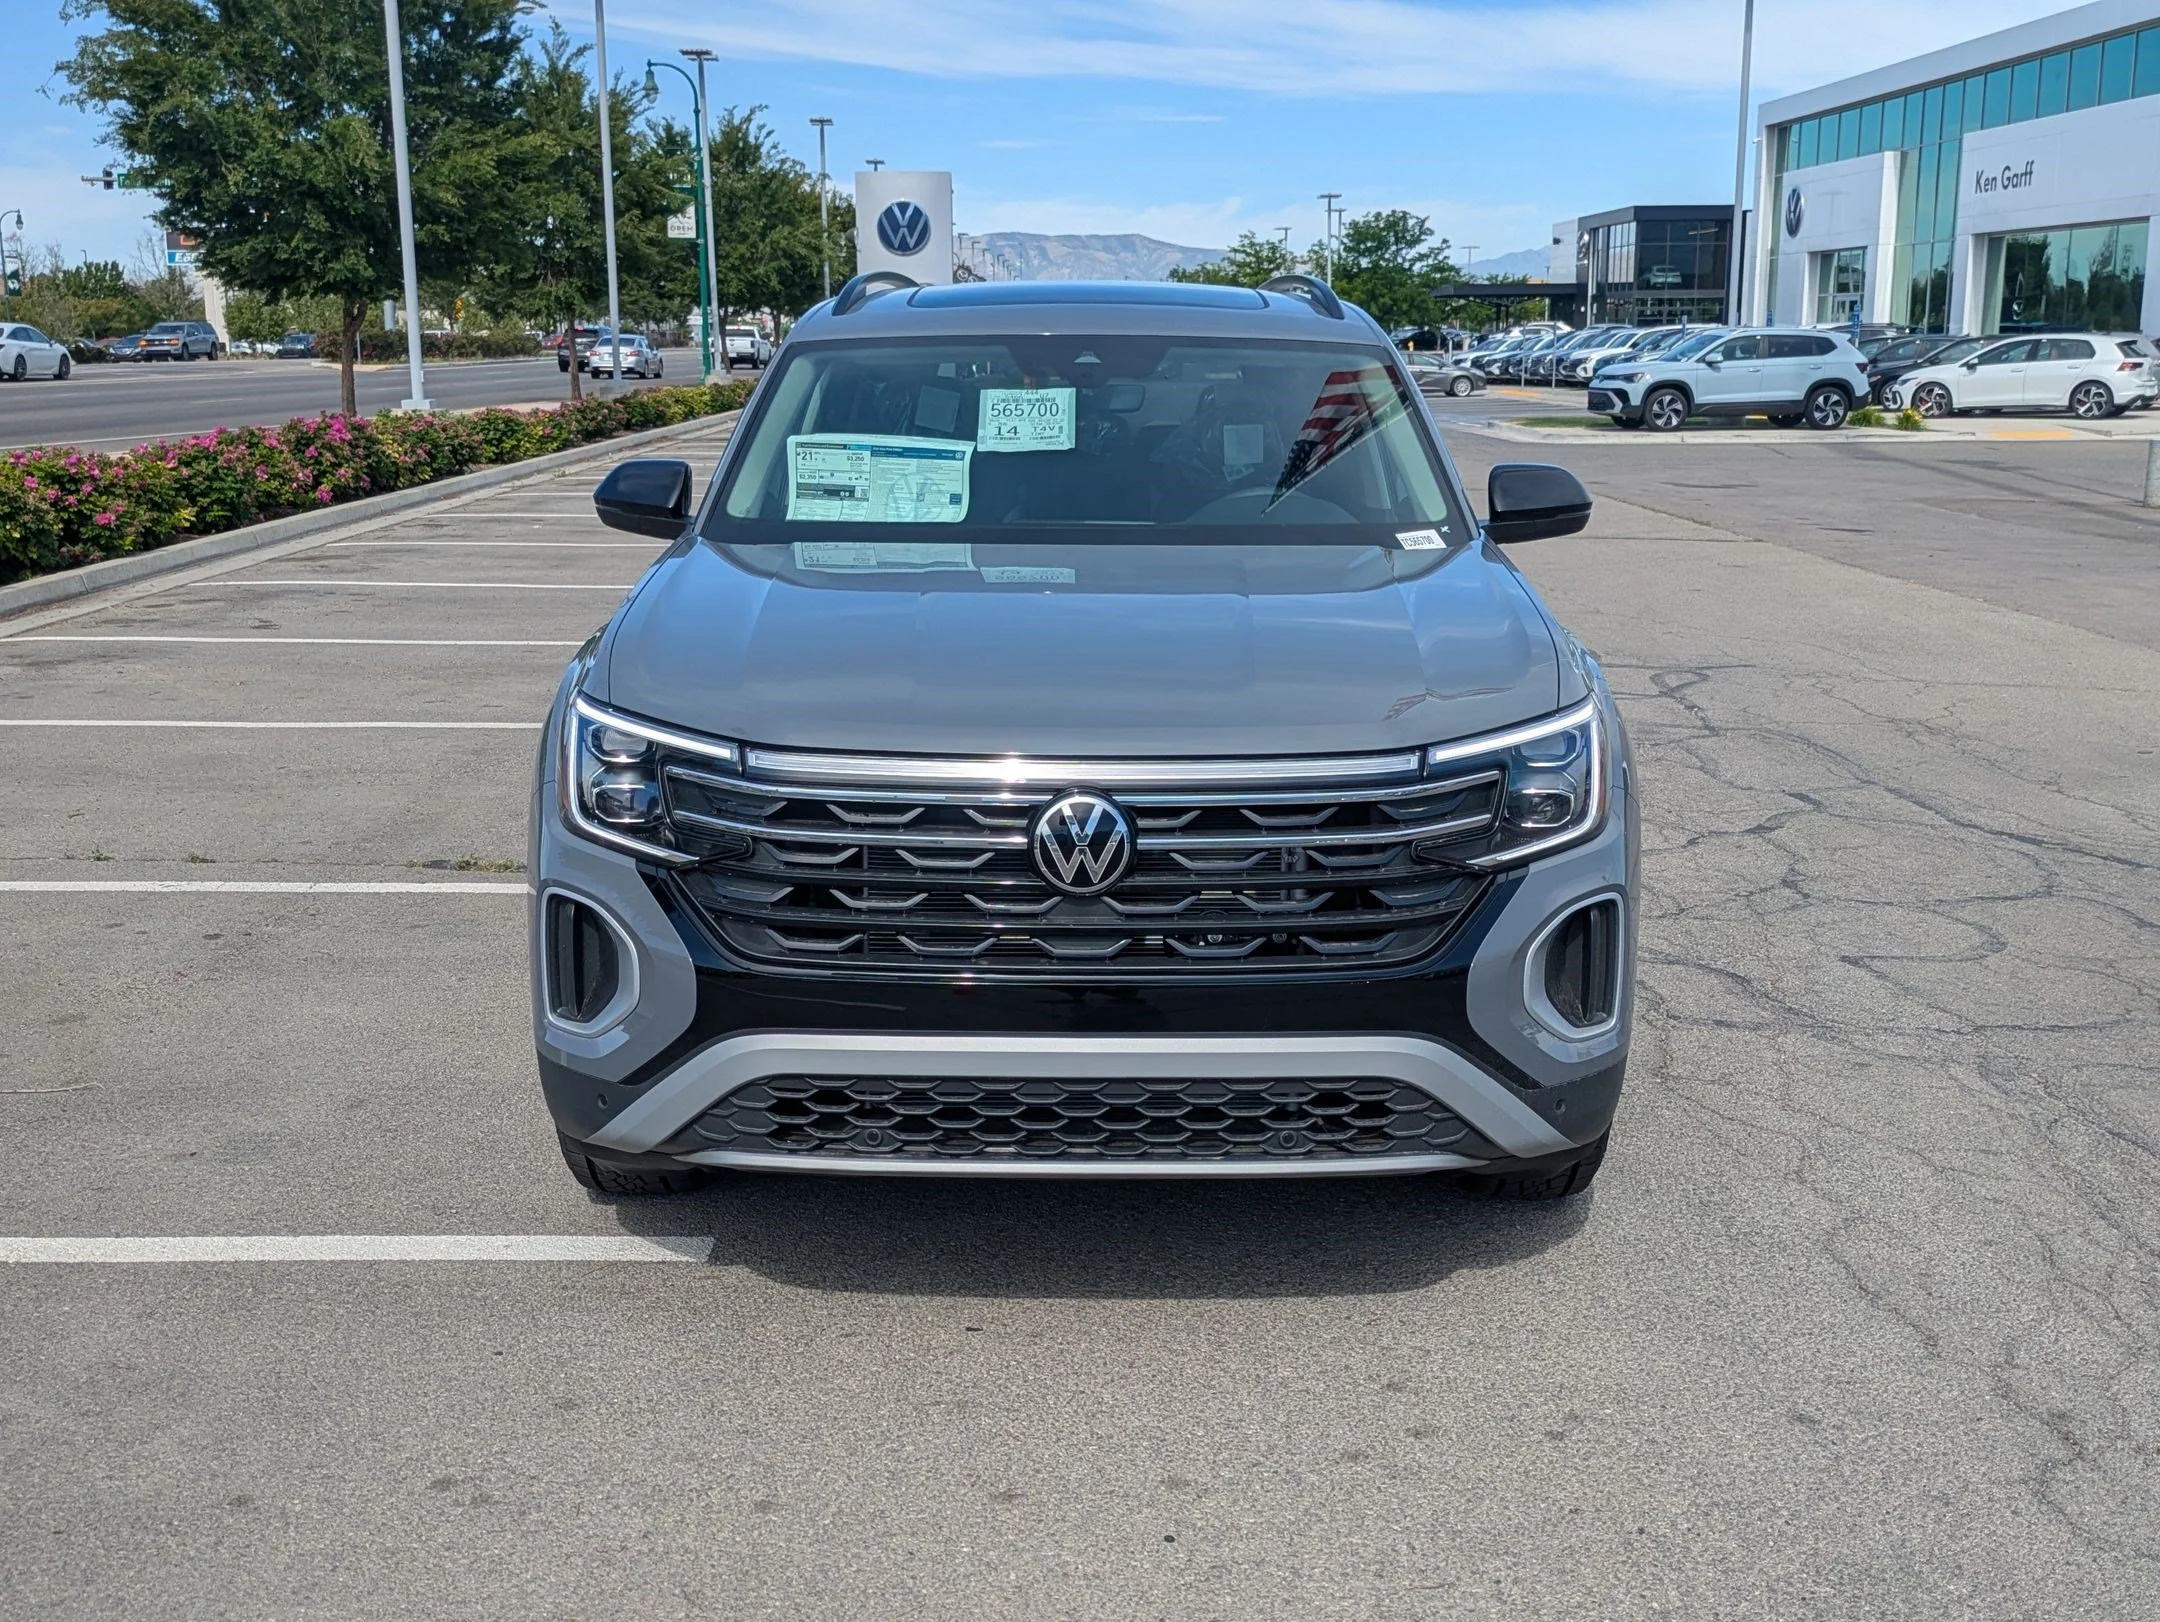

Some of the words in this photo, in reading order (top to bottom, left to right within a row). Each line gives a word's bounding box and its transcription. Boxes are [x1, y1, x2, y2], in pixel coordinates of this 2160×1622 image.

[1975, 169, 1997, 194] Ken
[2001, 160, 2034, 190] Garff
[880, 202, 928, 251] VW
[990, 402, 1060, 418] 565700
[994, 425, 1020, 437] 14
[801, 451, 813, 461] 21
[1036, 800, 1128, 888] VW
